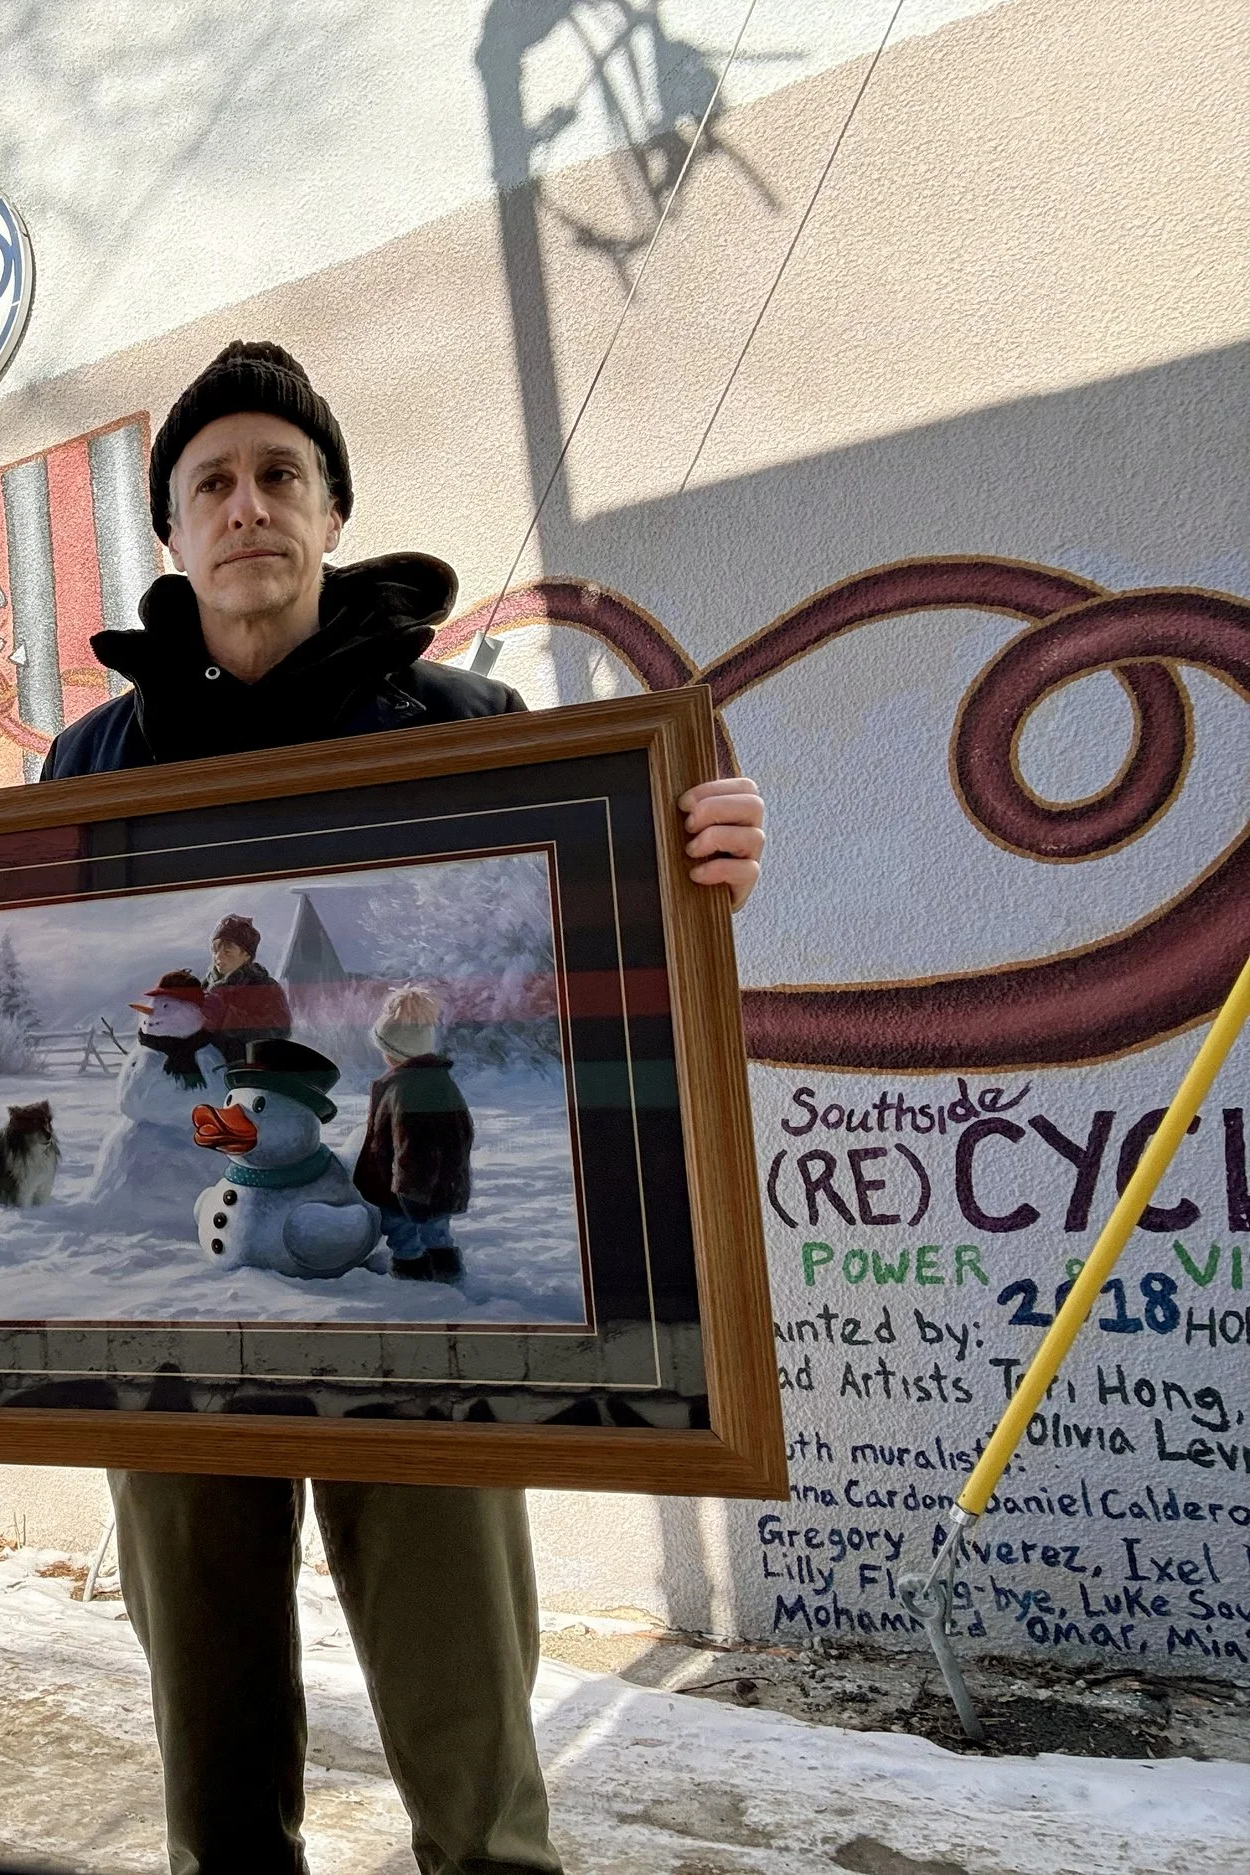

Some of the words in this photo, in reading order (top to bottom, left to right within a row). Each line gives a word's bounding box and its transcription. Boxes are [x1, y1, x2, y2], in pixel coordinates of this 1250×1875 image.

[780, 1077, 1032, 1137] Southside
[801, 1241, 990, 1287] POWER
[1172, 1239, 1250, 1291] VI
[774, 1303, 896, 1346] ainted
[913, 1307, 985, 1362] by:
[1185, 1305, 1250, 1349] HO
[777, 1353, 815, 1392] ad
[839, 1356, 973, 1403] Artists
[1096, 1363, 1244, 1433] Hong,
[850, 1435, 1027, 1475] muralist:
[1026, 1412, 1138, 1455] Olivia
[843, 1478, 956, 1512] Cardon
[757, 1513, 905, 1562] Gregory
[1120, 1536, 1222, 1586] Ixel
[762, 1550, 834, 1596] Lilly
